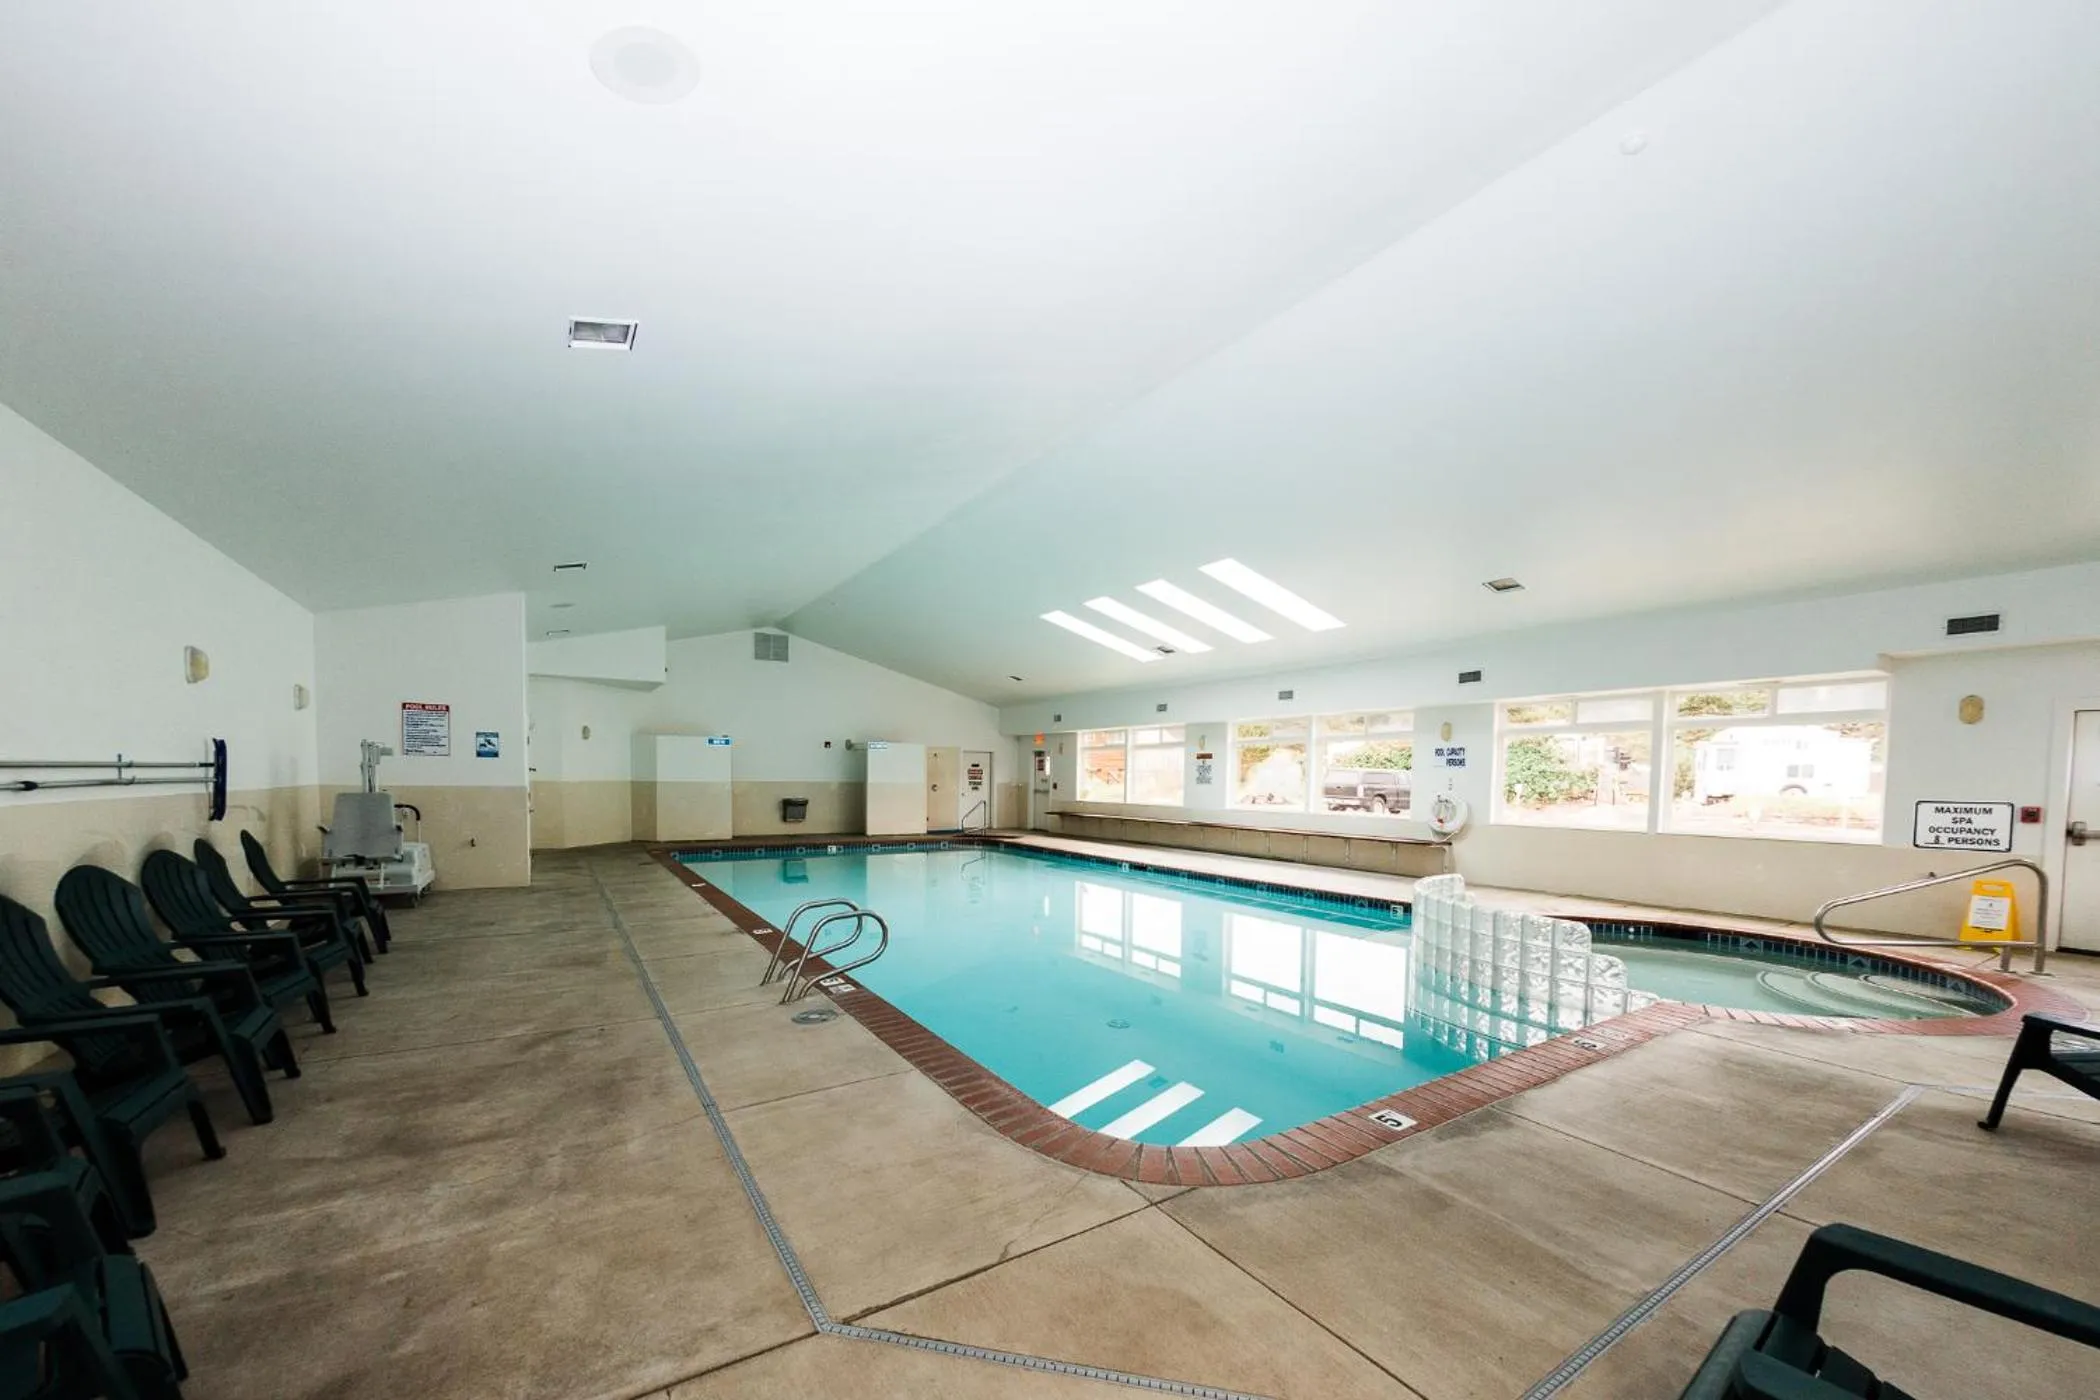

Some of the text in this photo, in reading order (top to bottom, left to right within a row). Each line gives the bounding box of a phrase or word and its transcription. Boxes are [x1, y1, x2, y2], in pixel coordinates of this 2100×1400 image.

[1934, 806, 1993, 815] MAXIMUM
[1928, 826, 1997, 836] OCCUPANCY
[1947, 836, 2000, 846] PERSONS
[1375, 1115, 1402, 1127] 5
